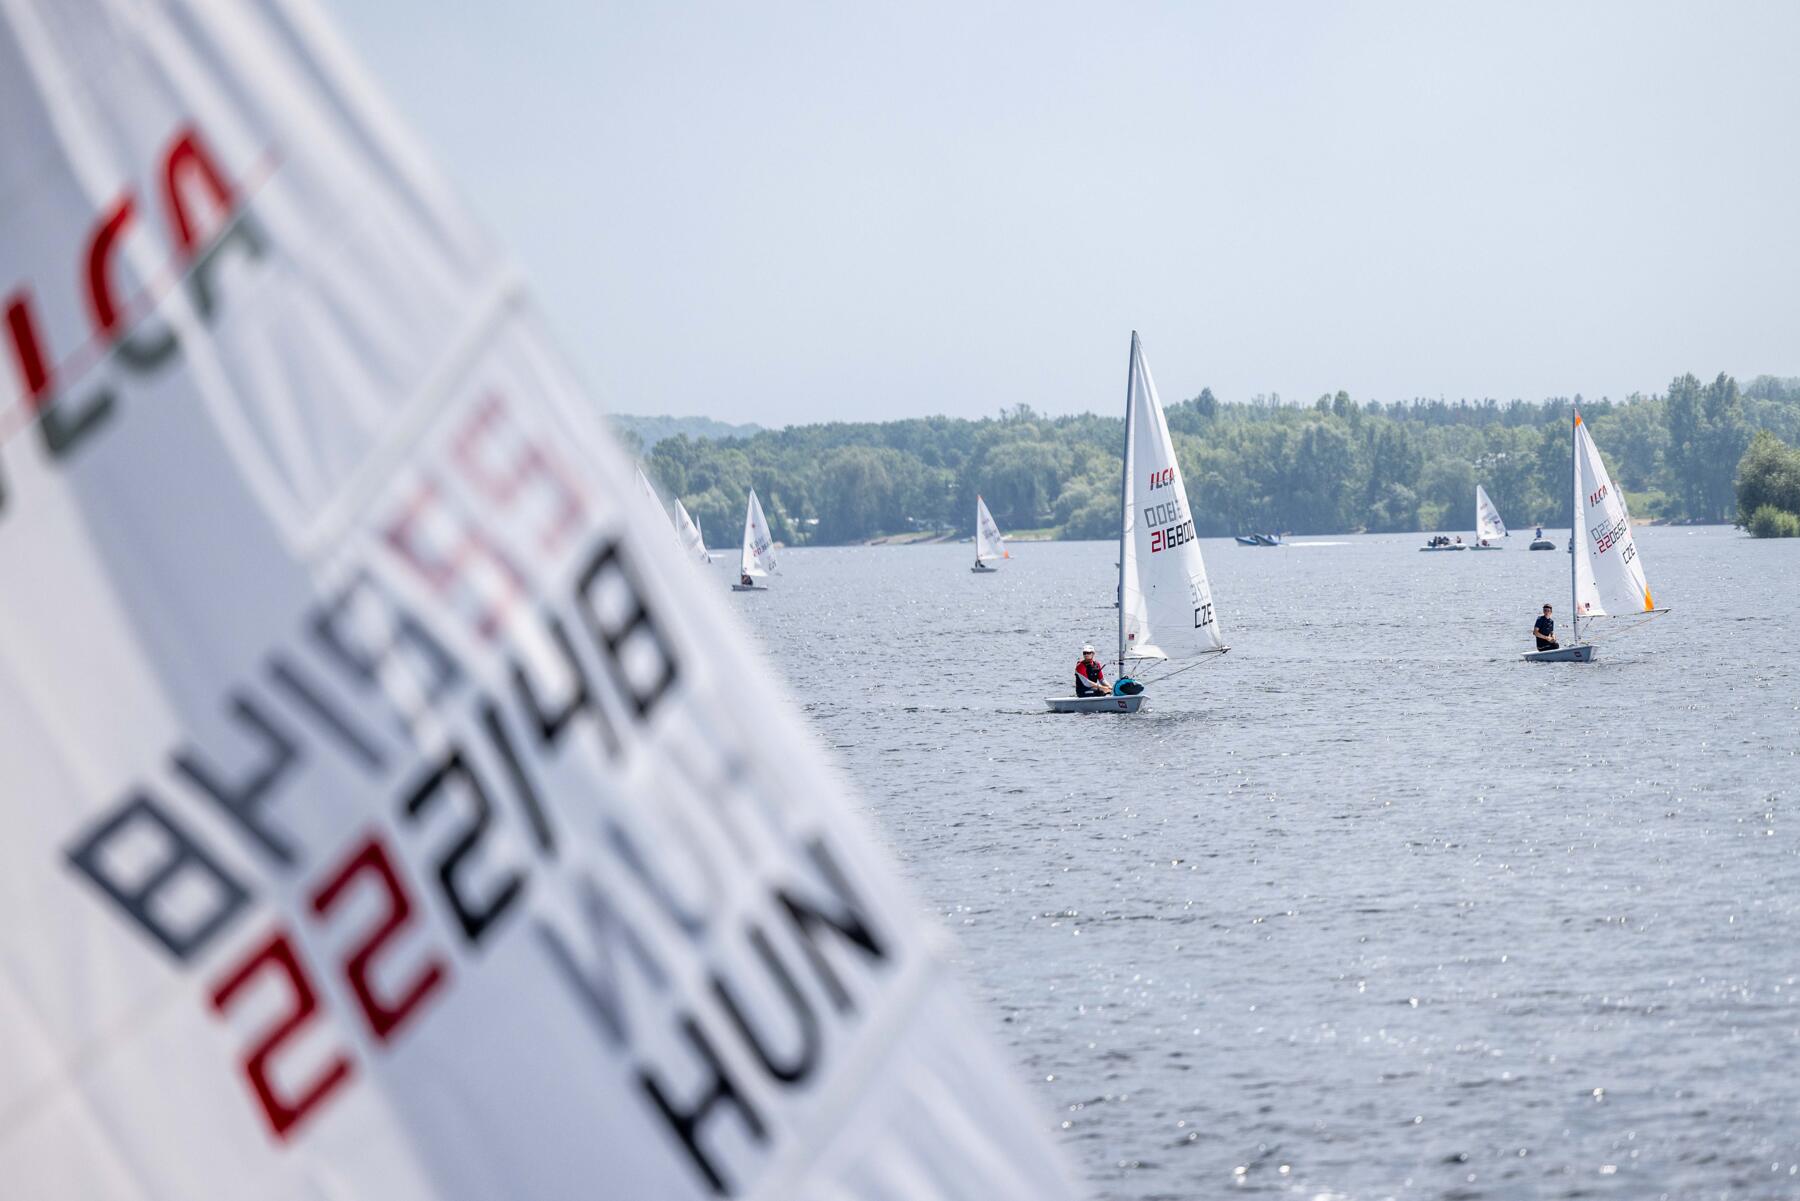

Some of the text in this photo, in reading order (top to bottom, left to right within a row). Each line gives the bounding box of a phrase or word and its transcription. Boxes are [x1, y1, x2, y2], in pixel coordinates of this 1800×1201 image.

[0, 120, 272, 518] LCA
[1150, 467, 1175, 490] ILCA
[1590, 485, 1608, 507] ILCA
[1151, 519, 1194, 553] 216800
[1596, 518, 1627, 554] 220650
[1622, 543, 1635, 564] CZE
[1194, 603, 1213, 628] CZE
[204, 536, 682, 1142] 222148
[638, 835, 892, 1198] HUN
